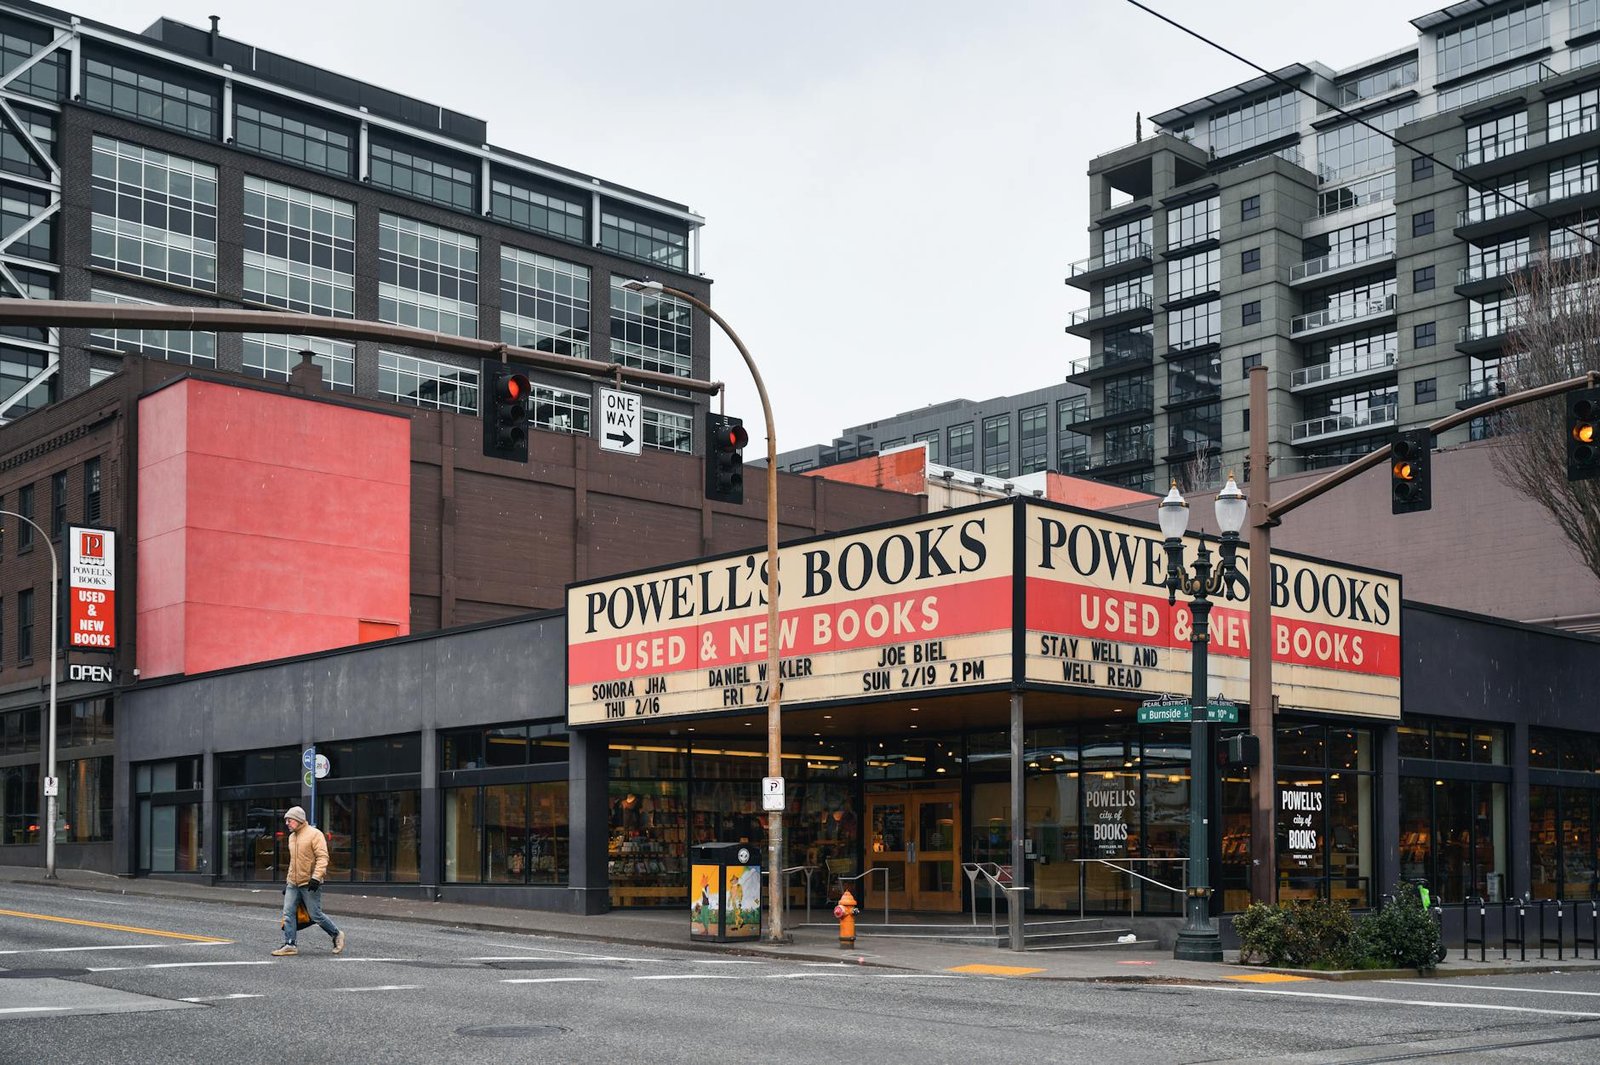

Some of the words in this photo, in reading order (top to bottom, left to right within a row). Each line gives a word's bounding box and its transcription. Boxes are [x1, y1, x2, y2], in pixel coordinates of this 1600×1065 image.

[607, 394, 635, 412] ONE
[606, 410, 636, 429] WAY
[801, 517, 987, 599] BOOKS
[78, 575, 107, 586] BOOKS
[78, 590, 106, 604] USED
[1270, 562, 1391, 626] BOOKS
[87, 603, 97, 617] &
[79, 619, 105, 632] NEW
[615, 635, 686, 672] USED
[700, 630, 718, 662] &
[729, 616, 799, 657] NEW
[813, 595, 940, 646] BOOKS
[1080, 593, 1160, 637] USED
[1173, 608, 1193, 642] &
[1276, 624, 1364, 666] BOOKS
[73, 632, 111, 647] BOOKS
[877, 645, 906, 668] JOE
[913, 641, 947, 664] BIEL
[1040, 634, 1079, 659] STAY
[1091, 641, 1123, 664] WELL
[1133, 647, 1158, 668] AND
[70, 664, 113, 683] OPEN
[708, 665, 751, 688] DANIEL
[862, 670, 891, 692] SUN
[901, 665, 937, 688] 2/19
[1062, 660, 1095, 685] WELL
[1107, 666, 1142, 689] READ
[592, 680, 635, 701] SONORA
[644, 676, 667, 695] JHA
[723, 687, 744, 707] FRI
[604, 702, 626, 719] THU
[635, 696, 660, 716] 2/16
[1162, 699, 1187, 707] DISTRICT
[1149, 708, 1181, 720] Burnside
[1086, 789, 1136, 808] POWELL'S
[1282, 790, 1323, 812] POWELL'S
[1099, 810, 1113, 821] city
[1113, 809, 1123, 821] of
[1293, 813, 1304, 827] city
[1304, 813, 1313, 828] of
[1093, 823, 1128, 841] BOOKS
[1288, 829, 1317, 850] BOOKS
